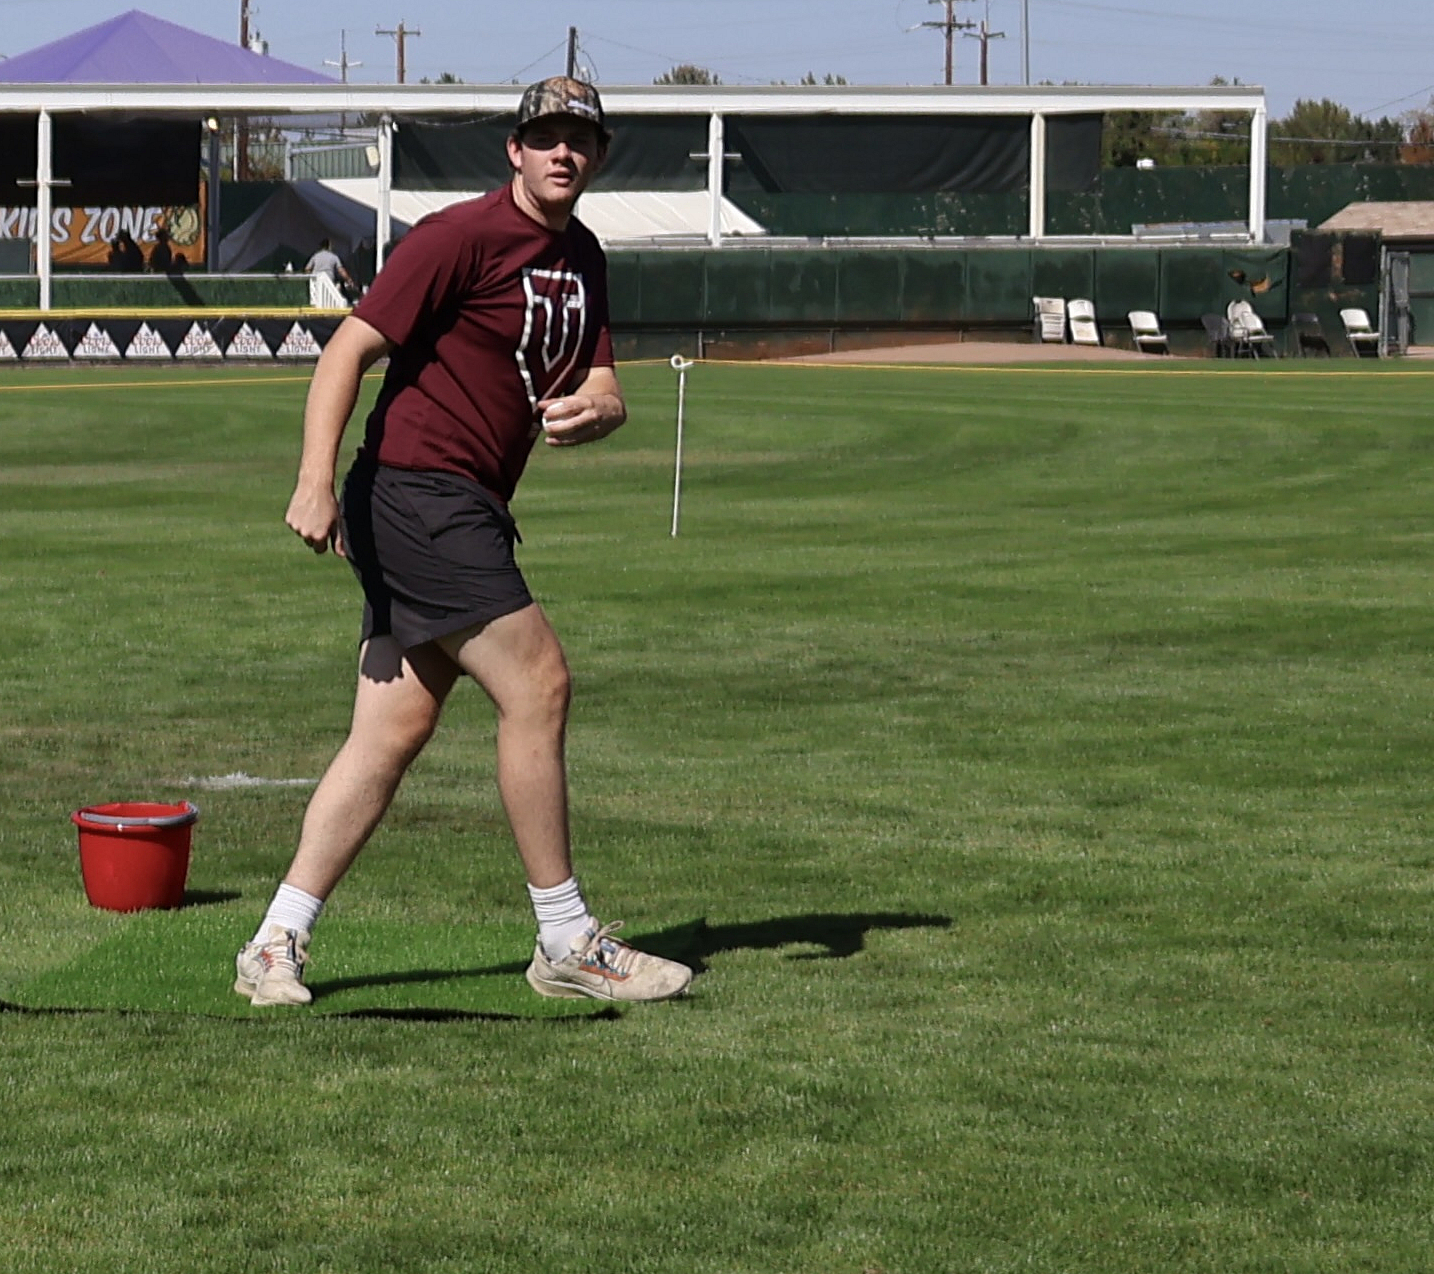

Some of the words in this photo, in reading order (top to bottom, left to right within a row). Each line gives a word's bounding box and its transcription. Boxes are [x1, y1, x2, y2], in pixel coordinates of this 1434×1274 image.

[80, 207, 163, 244] ZONE
[29, 334, 61, 347] Coors
[80, 334, 112, 347] Coors
[132, 334, 163, 347] Coors
[182, 334, 213, 347] Coors
[233, 334, 264, 347] Coors
[283, 333, 315, 346] Coors
[31, 346, 57, 354] LIGHT
[83, 346, 109, 354] LIGHT
[135, 346, 160, 354] LIGHT
[185, 346, 211, 354] LIGHT
[235, 346, 261, 354] LIGHT
[286, 345, 312, 353] LIGHT
